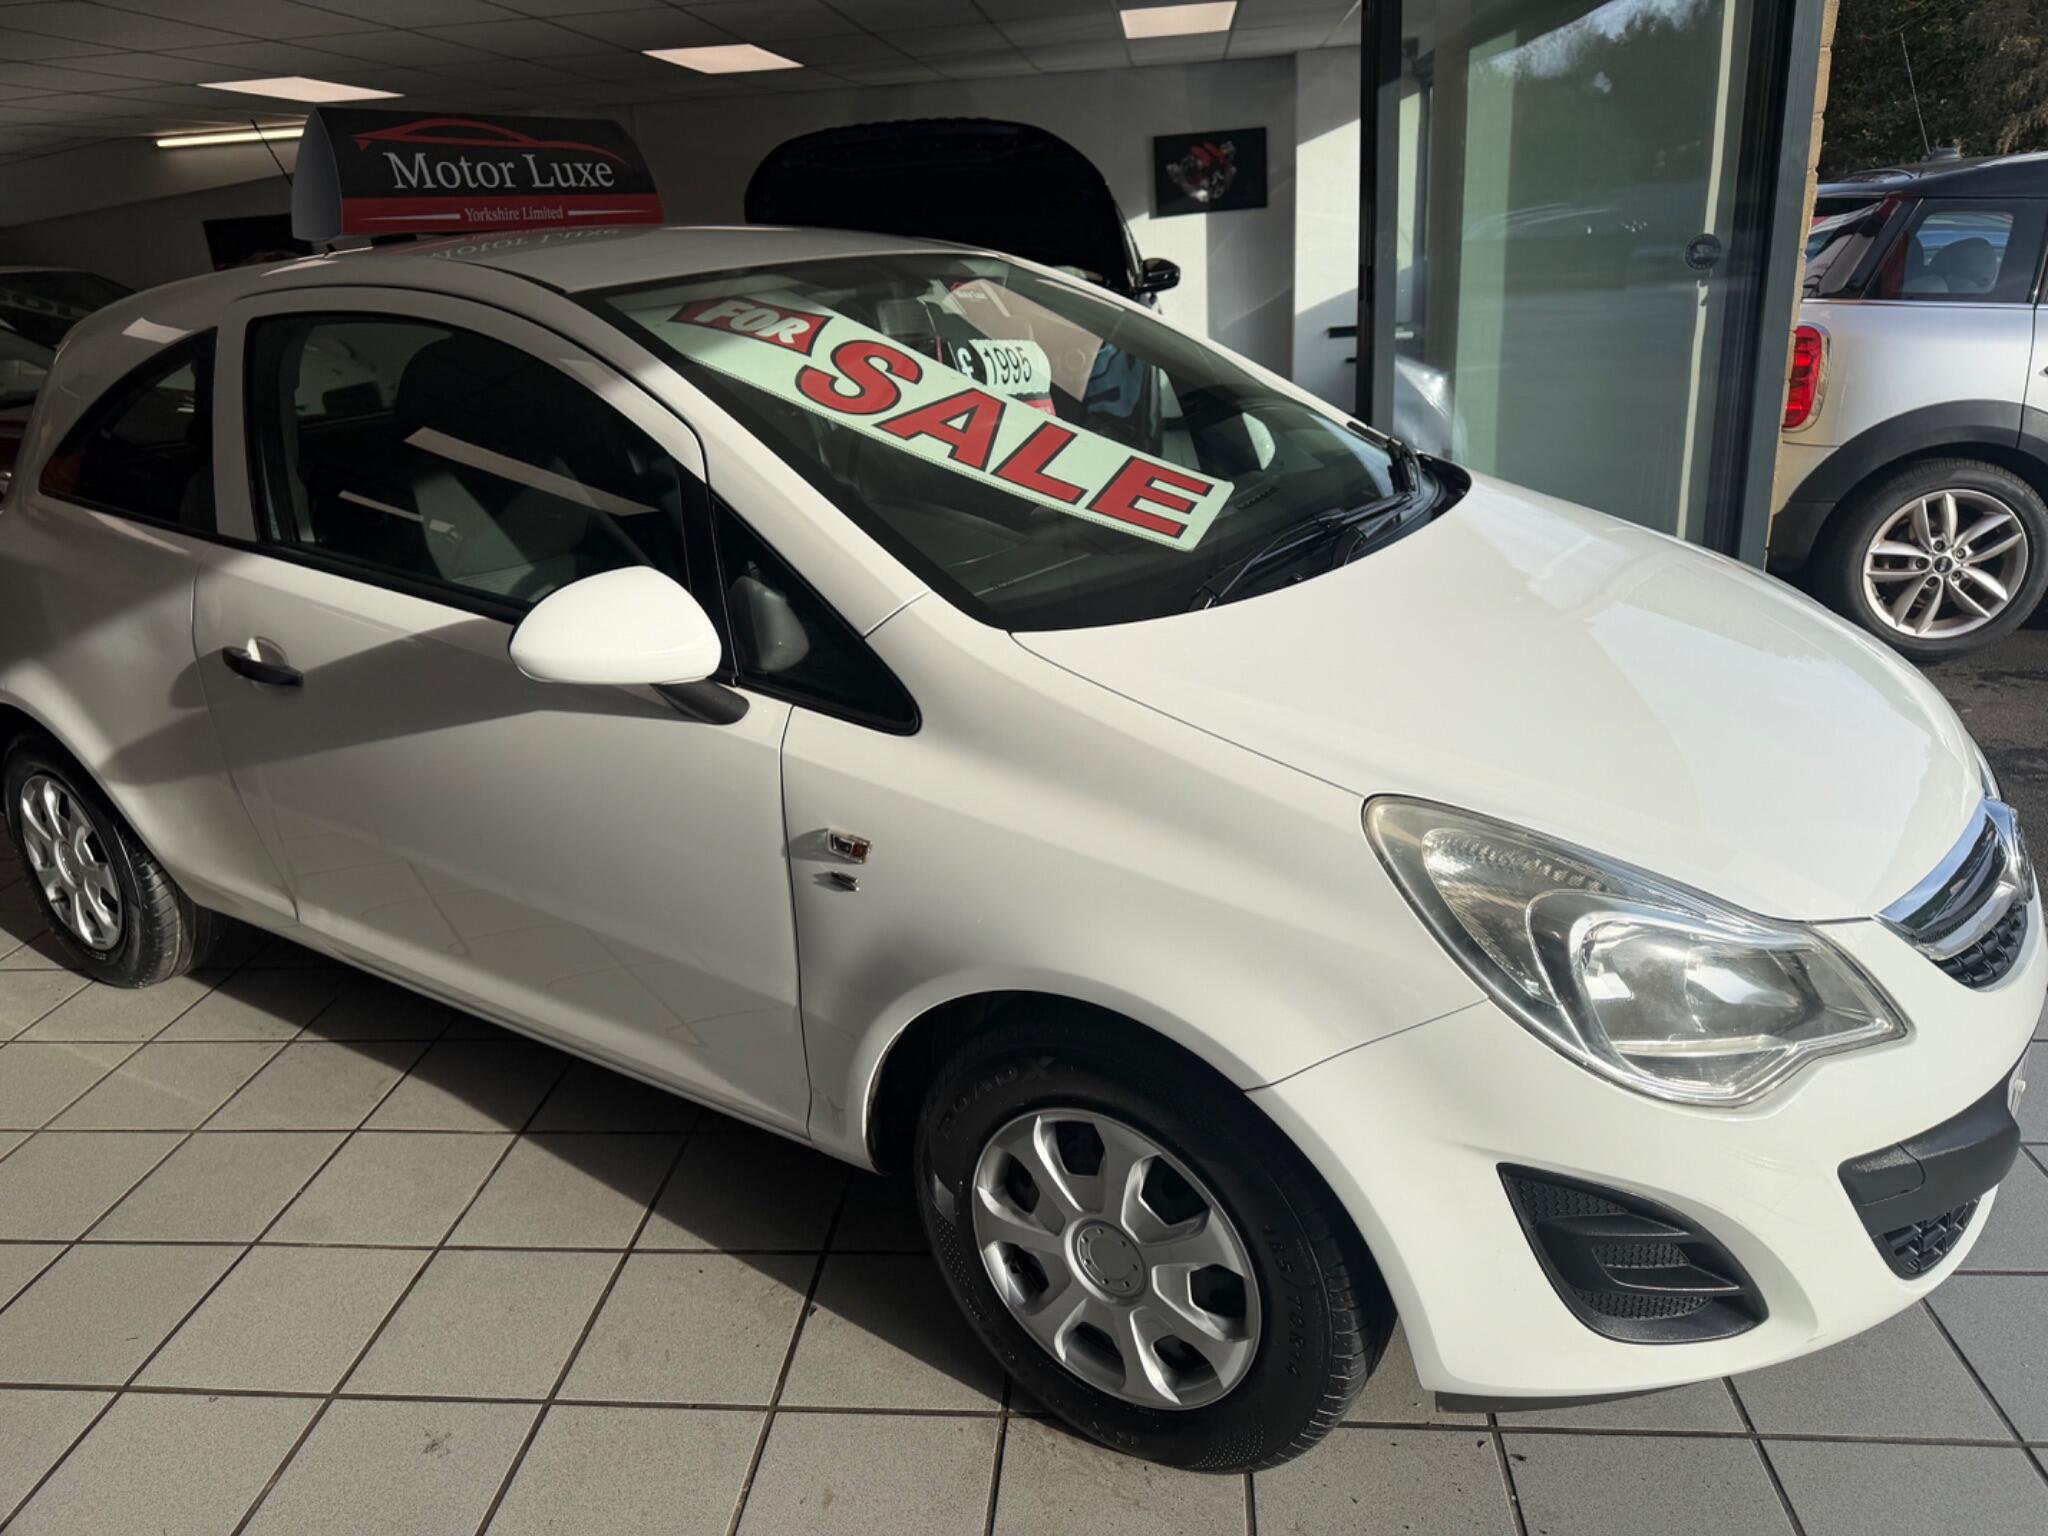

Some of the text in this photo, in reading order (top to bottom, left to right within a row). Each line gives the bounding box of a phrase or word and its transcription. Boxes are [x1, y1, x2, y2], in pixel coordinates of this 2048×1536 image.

[384, 152, 615, 189] Motor Luxe
[464, 205, 564, 223] Yorkshire Limited
[983, 347, 1033, 385] 1995
[696, 300, 1216, 538] FOR SALE
